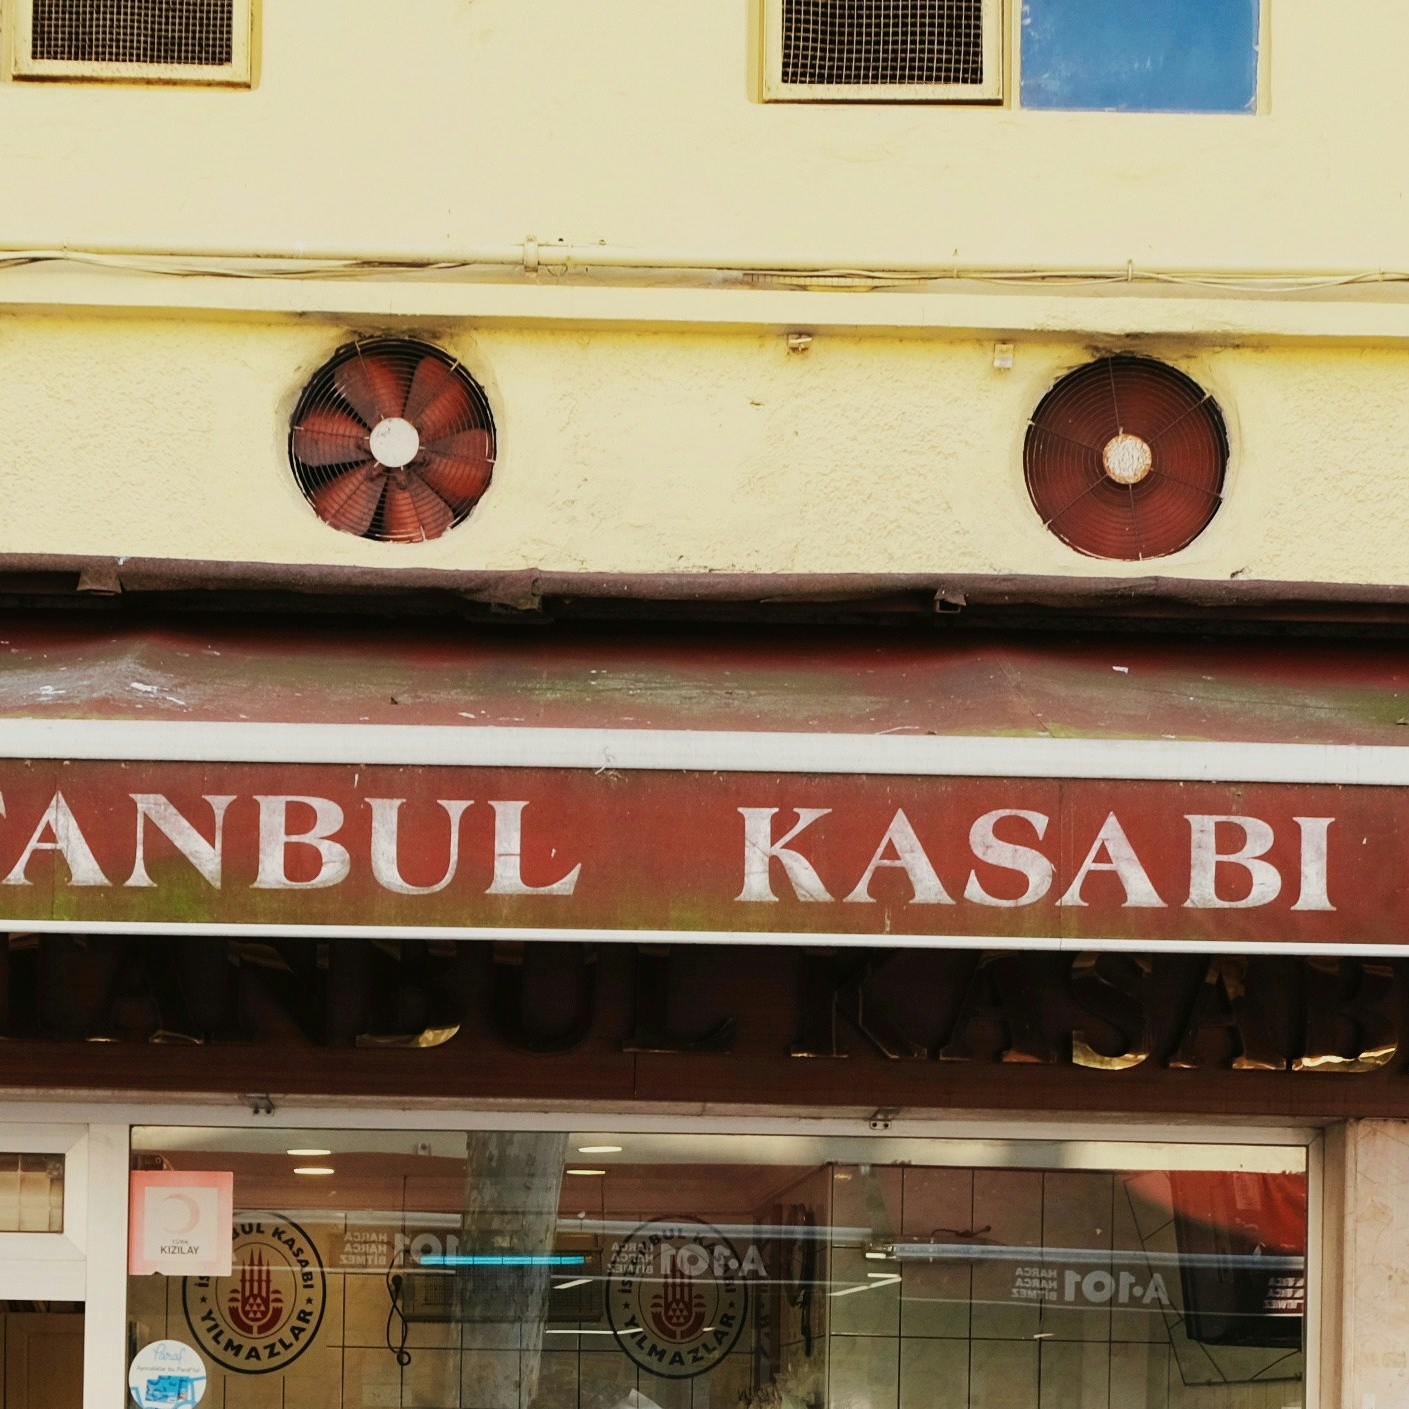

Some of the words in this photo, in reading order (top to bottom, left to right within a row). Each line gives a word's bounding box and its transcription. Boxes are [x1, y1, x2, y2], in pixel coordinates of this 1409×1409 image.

[734, 806, 1337, 911] KASABI
[160, 1245, 200, 1256] KIZILAY
[271, 1226, 315, 1289] KASABI
[199, 1307, 314, 1361] YILMAZLAR
[623, 1312, 737, 1367] YILMAZLAR
